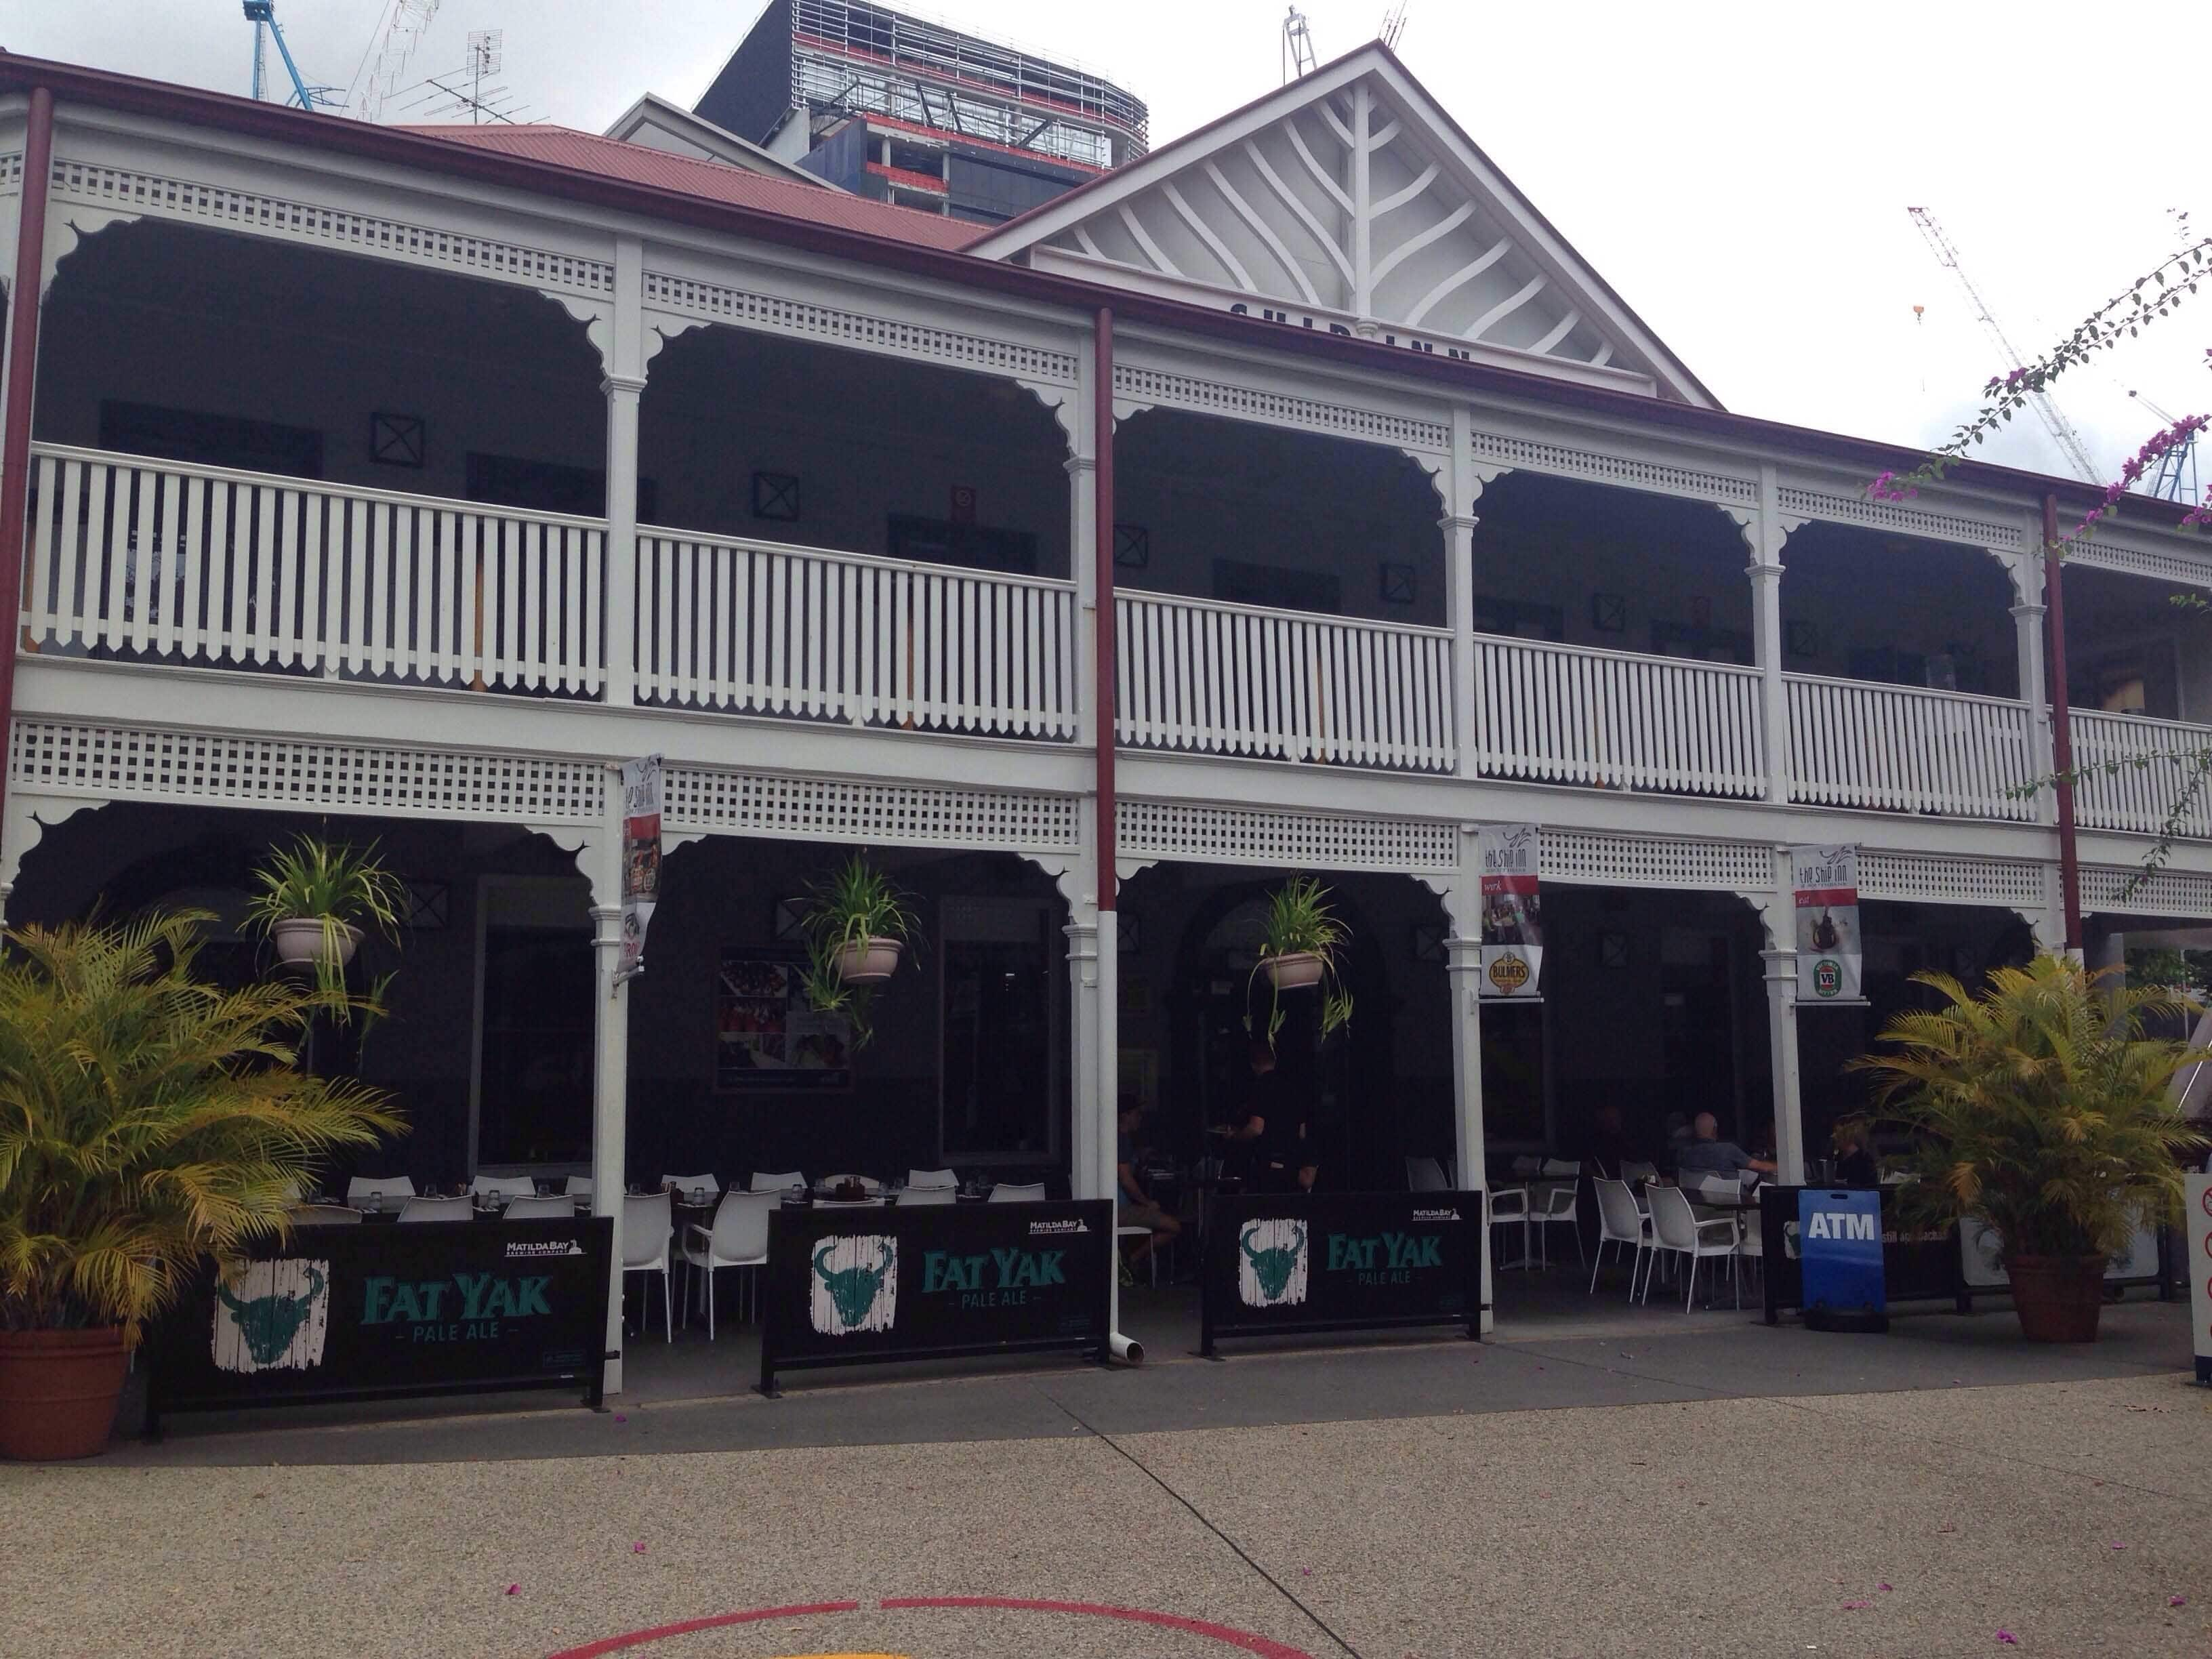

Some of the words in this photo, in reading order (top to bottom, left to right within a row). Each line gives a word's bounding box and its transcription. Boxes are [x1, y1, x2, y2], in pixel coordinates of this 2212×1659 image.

[1800, 867, 1812, 884] the
[1835, 865, 1847, 882] inn
[1493, 965, 1525, 977] BULMERS
[1821, 973, 1835, 983] VB
[1808, 1212, 1875, 1241] ATM
[507, 1242, 548, 1251] MATILDA
[550, 1241, 569, 1250] BAY
[1327, 1233, 1379, 1271] FAT
[1378, 1231, 1442, 1269] YAK
[922, 1250, 991, 1293] FAT
[990, 1248, 1067, 1288] YAK
[1359, 1271, 1387, 1286] PALE
[1391, 1270, 1411, 1285] ALE
[360, 1275, 452, 1325] FAT
[452, 1272, 553, 1319] YAK
[962, 1292, 997, 1309] PALE
[1001, 1290, 1027, 1306] ALE
[413, 1324, 459, 1343] PALE
[466, 1322, 500, 1339] ALE
